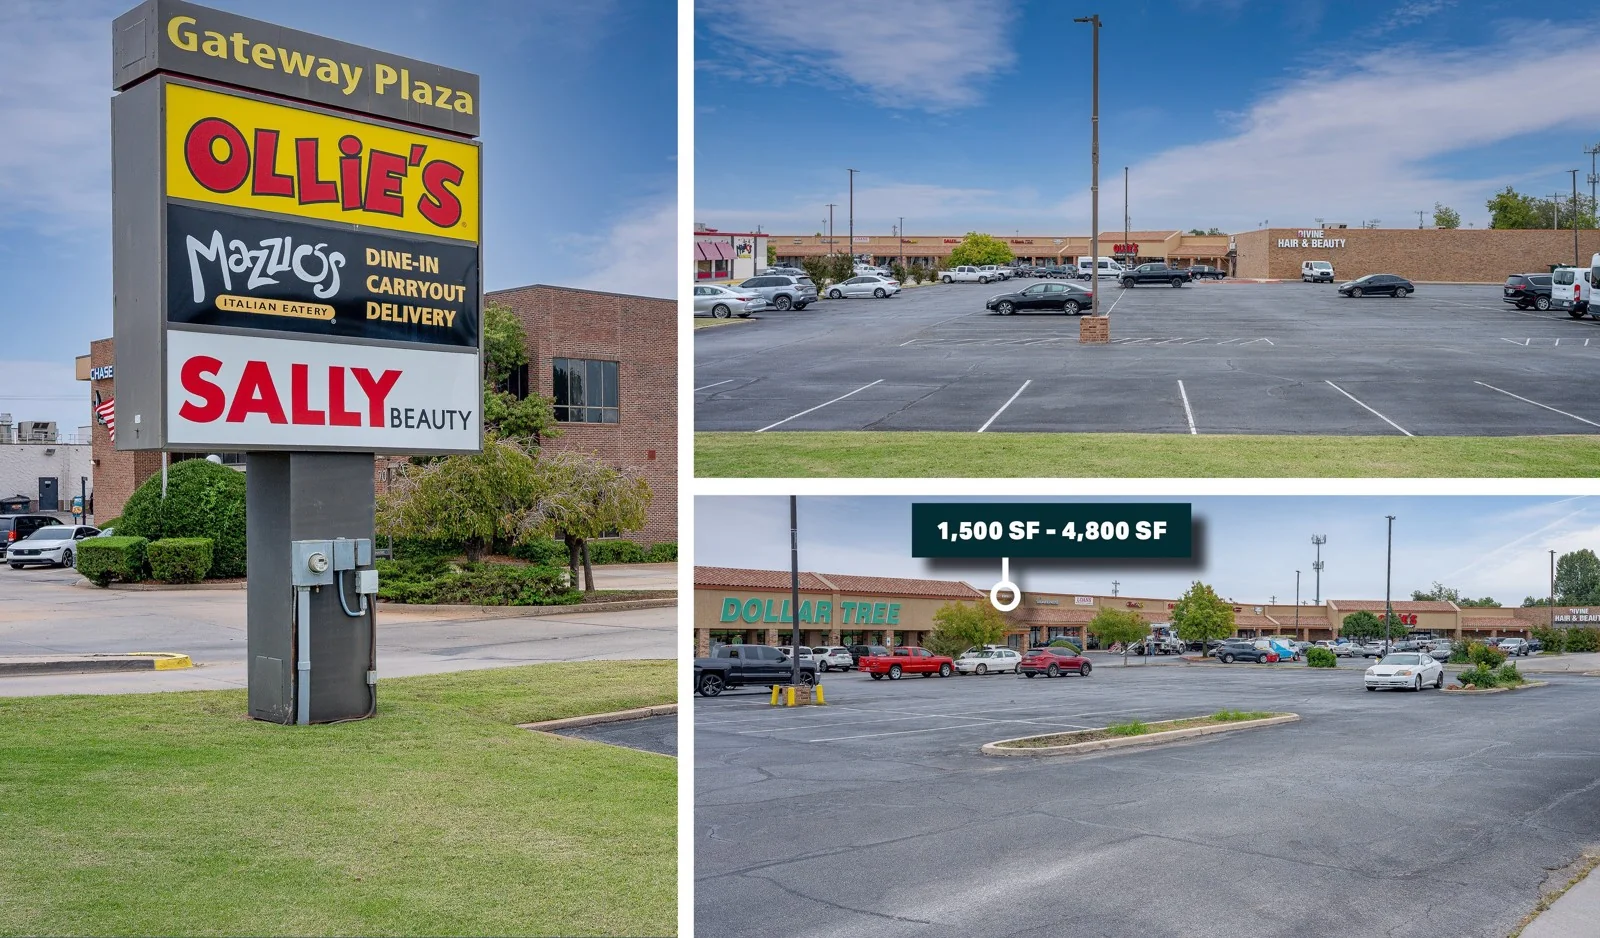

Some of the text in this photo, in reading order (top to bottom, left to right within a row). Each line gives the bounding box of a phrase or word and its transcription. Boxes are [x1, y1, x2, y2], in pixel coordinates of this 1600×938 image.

[167, 15, 474, 115] Gateway Plaza
[1278, 238, 1346, 248] HAIR & BEAUTY
[1297, 229, 1325, 239] DIVINE
[365, 247, 439, 275] DINE-IN
[366, 275, 466, 303] CARRYOUT
[223, 297, 328, 317] ITALIAN EATERY
[366, 301, 456, 328] DELIVERY
[90, 364, 114, 380] CHASE
[178, 355, 472, 431] SALLY BEAUTY
[719, 596, 901, 625] DOLLAR TREE
